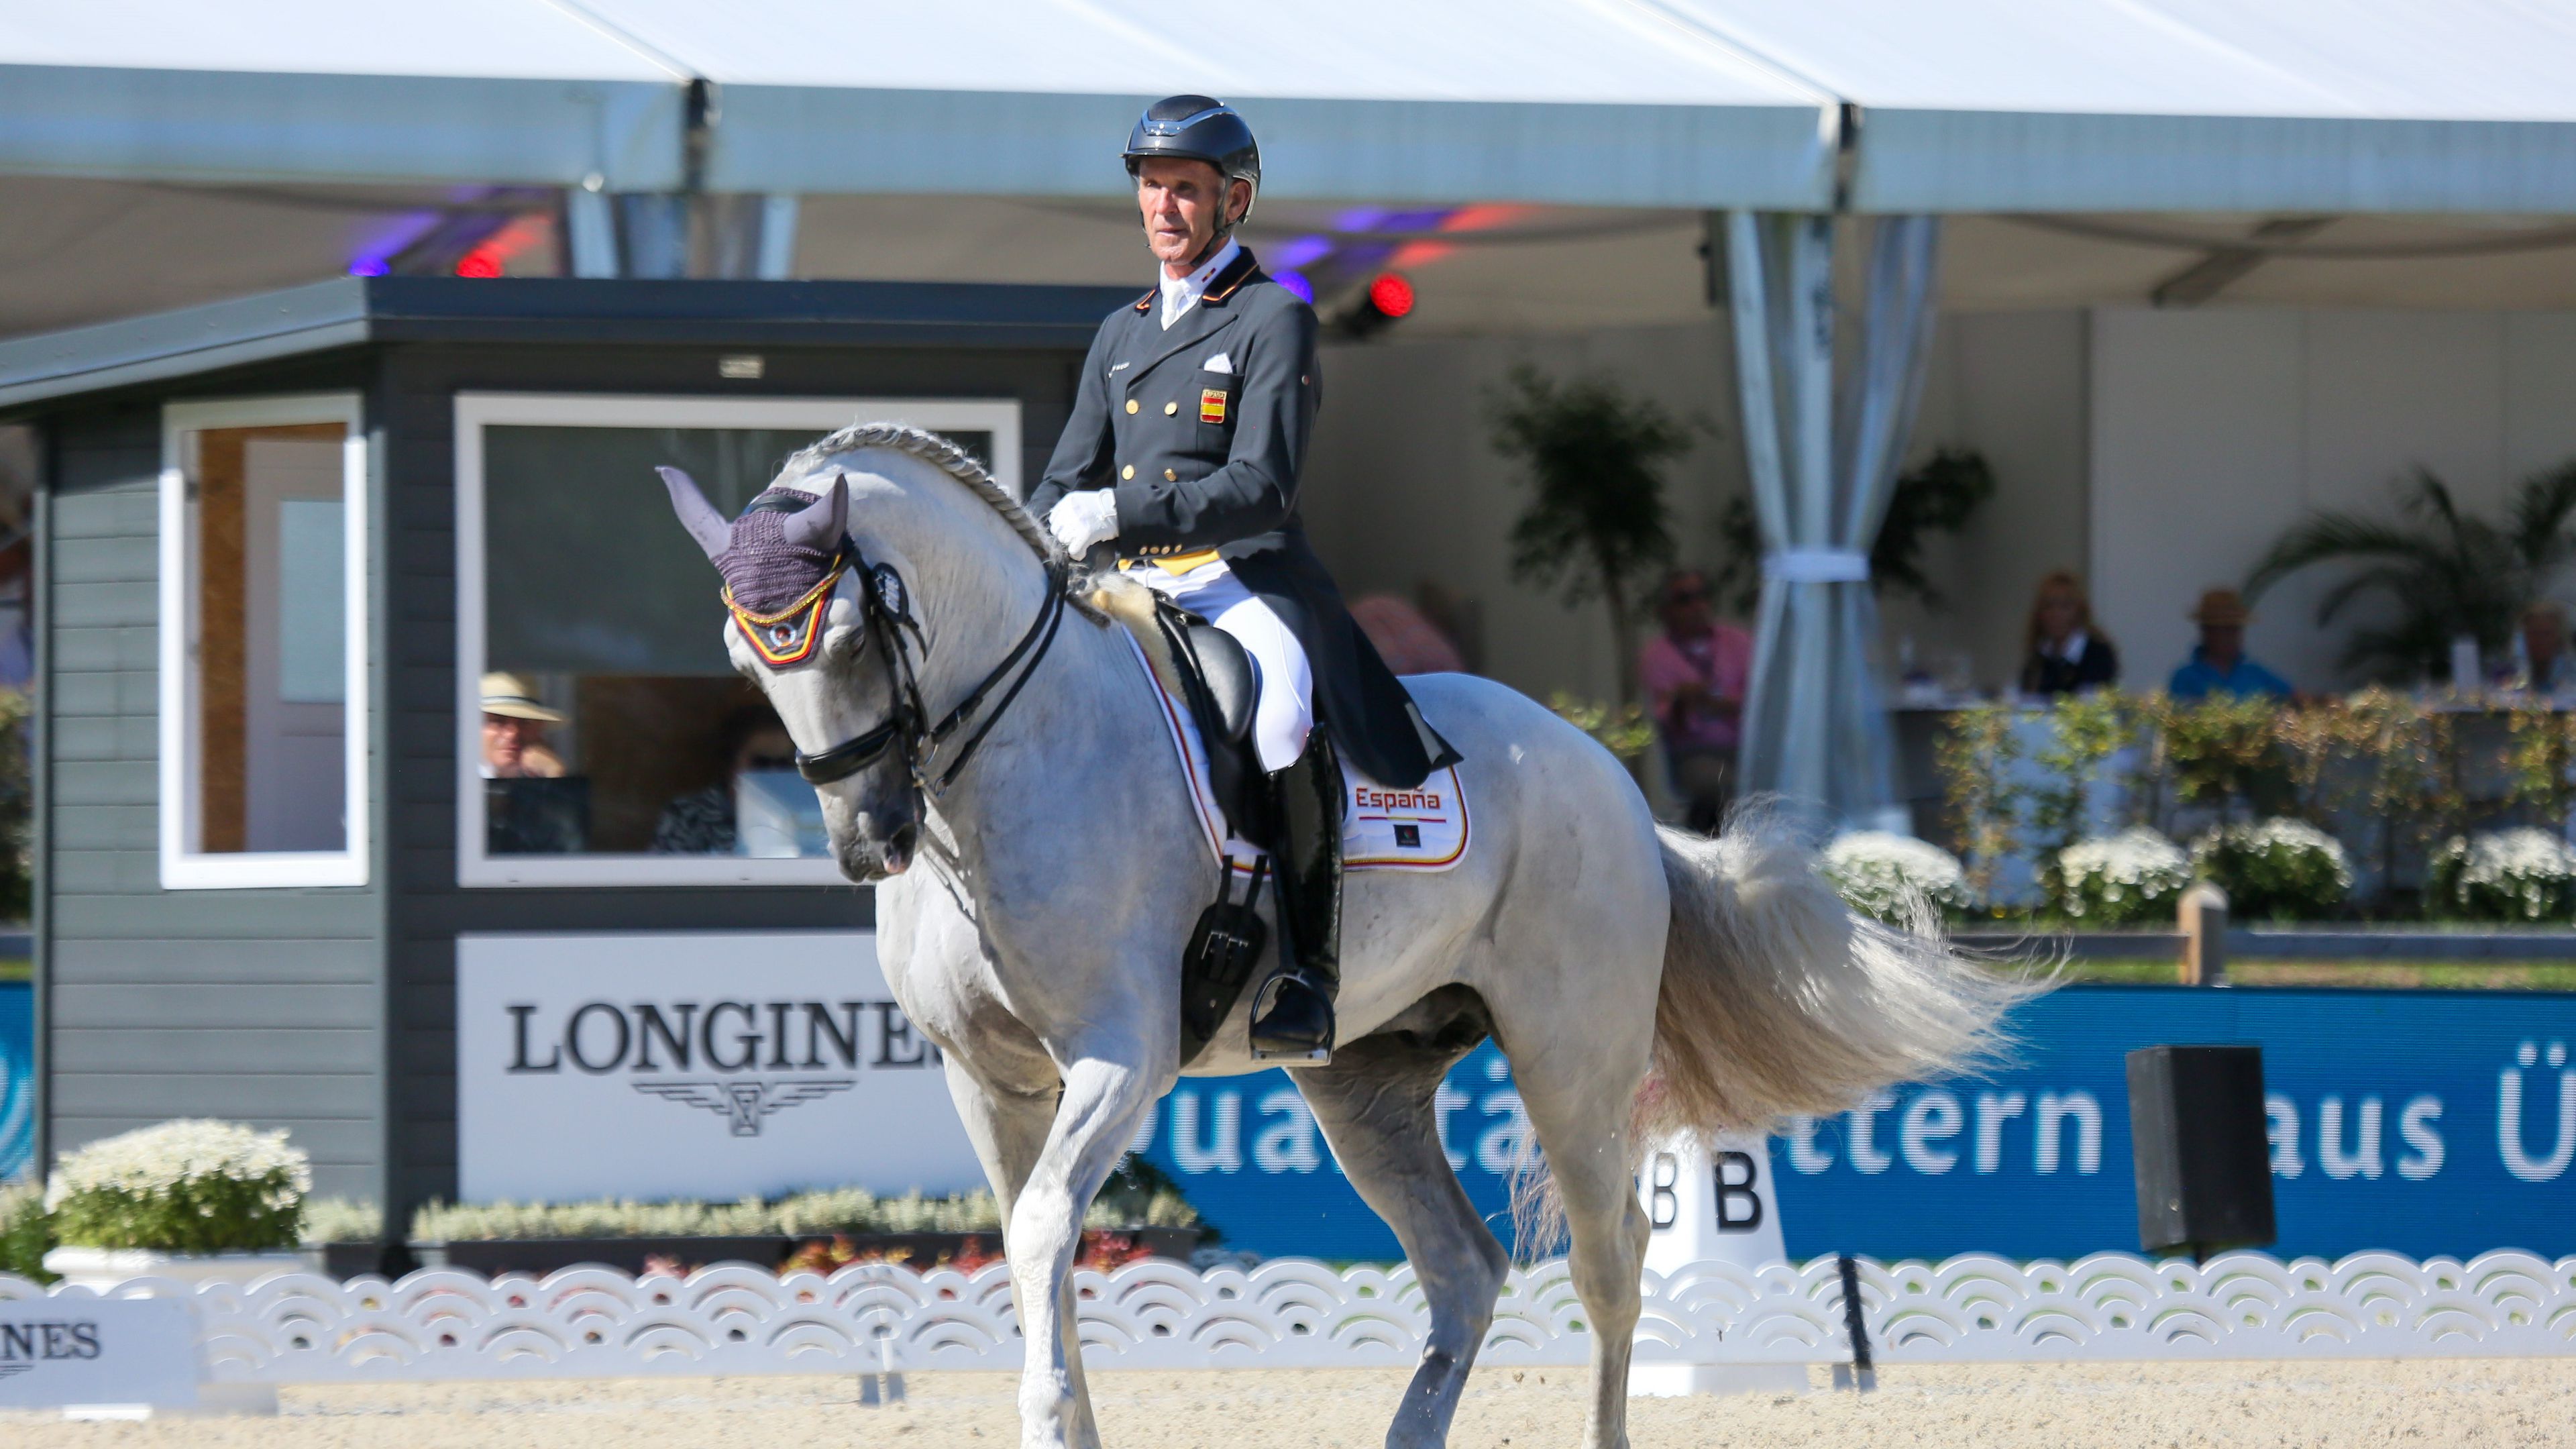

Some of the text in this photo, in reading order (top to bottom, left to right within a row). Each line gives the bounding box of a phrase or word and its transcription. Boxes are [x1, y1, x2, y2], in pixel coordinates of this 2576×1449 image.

[504, 1001, 942, 1073] LONGINE
[1651, 1152, 1678, 1230] B
[1714, 1150, 1763, 1236] B
